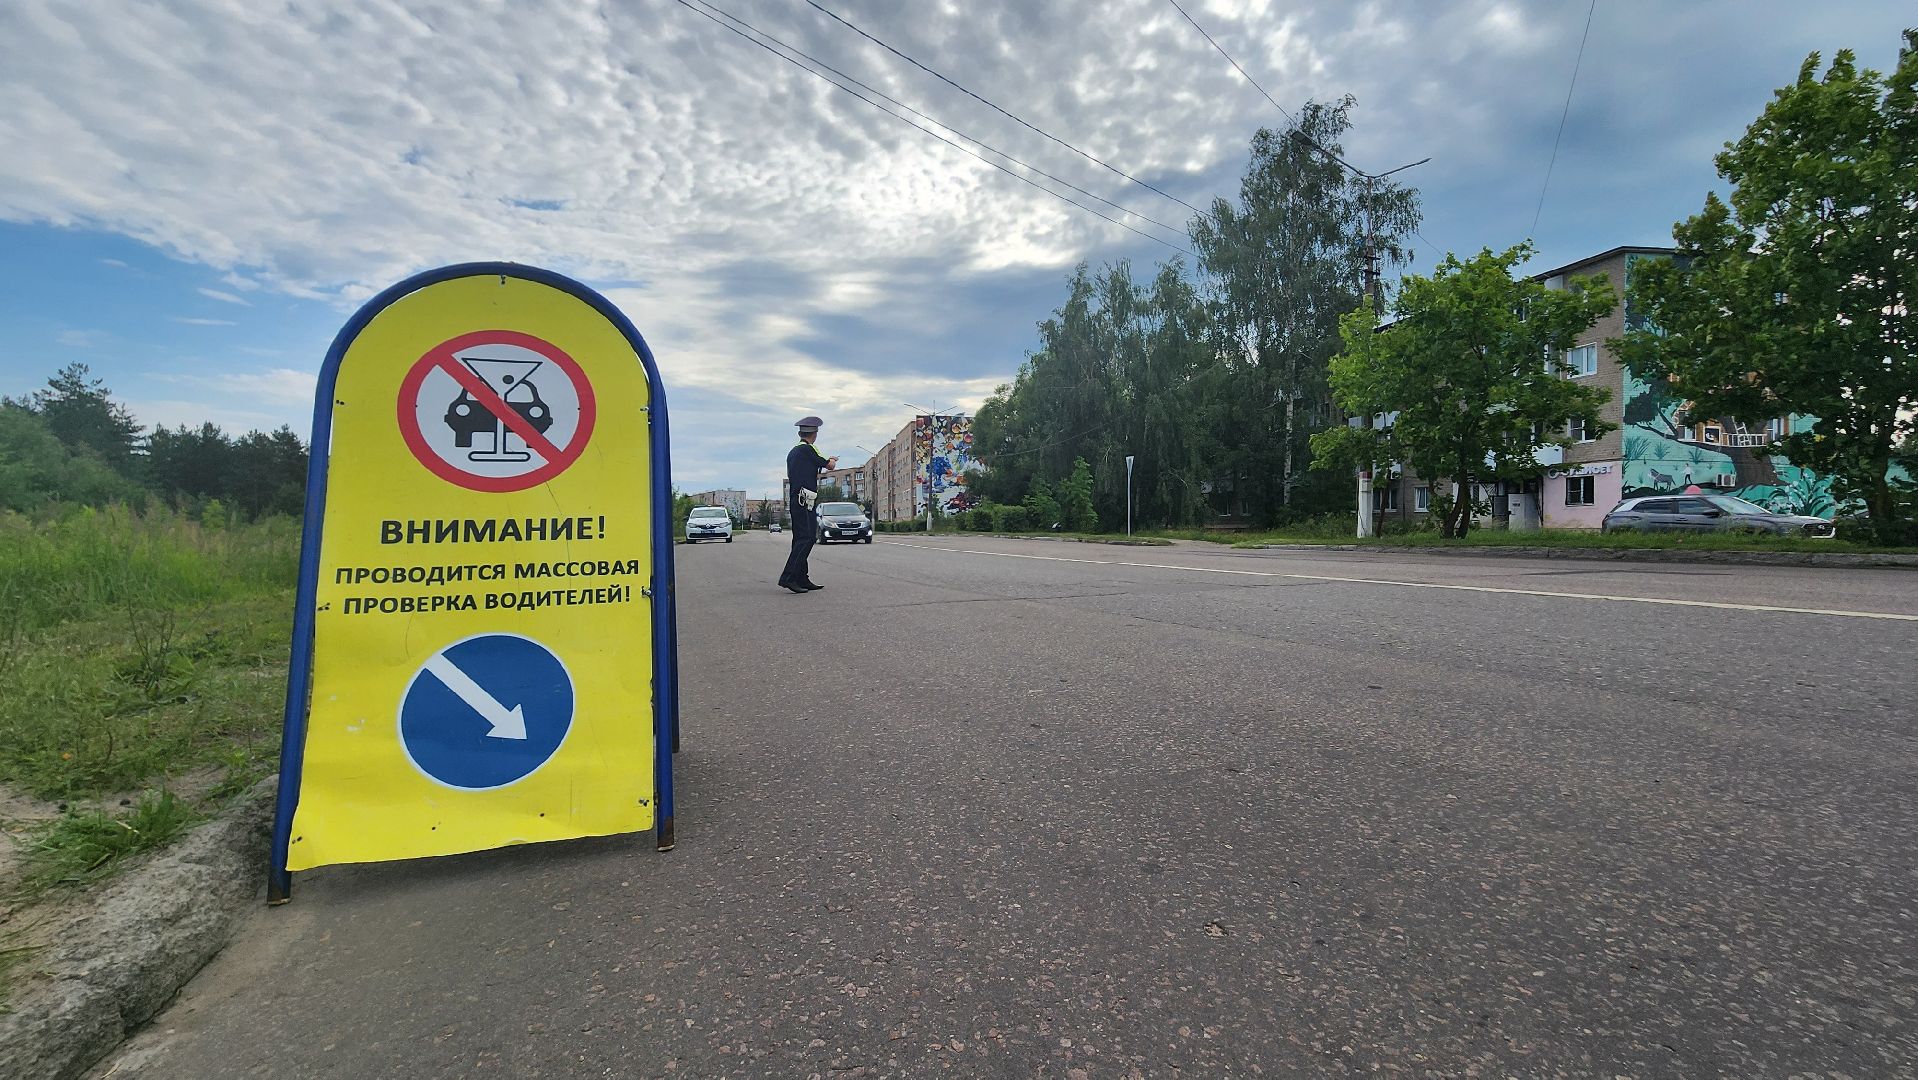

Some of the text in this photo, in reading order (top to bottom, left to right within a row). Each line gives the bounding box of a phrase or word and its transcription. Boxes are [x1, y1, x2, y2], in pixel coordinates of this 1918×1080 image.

[380, 515, 606, 545] ВНИМАНИЕ!
[335, 559, 640, 586] ПРОВОДИТСЯ МАССОВАЯ
[343, 584, 631, 615] ПРОВЕРКА ВОДИТЕЛЕЙ!
